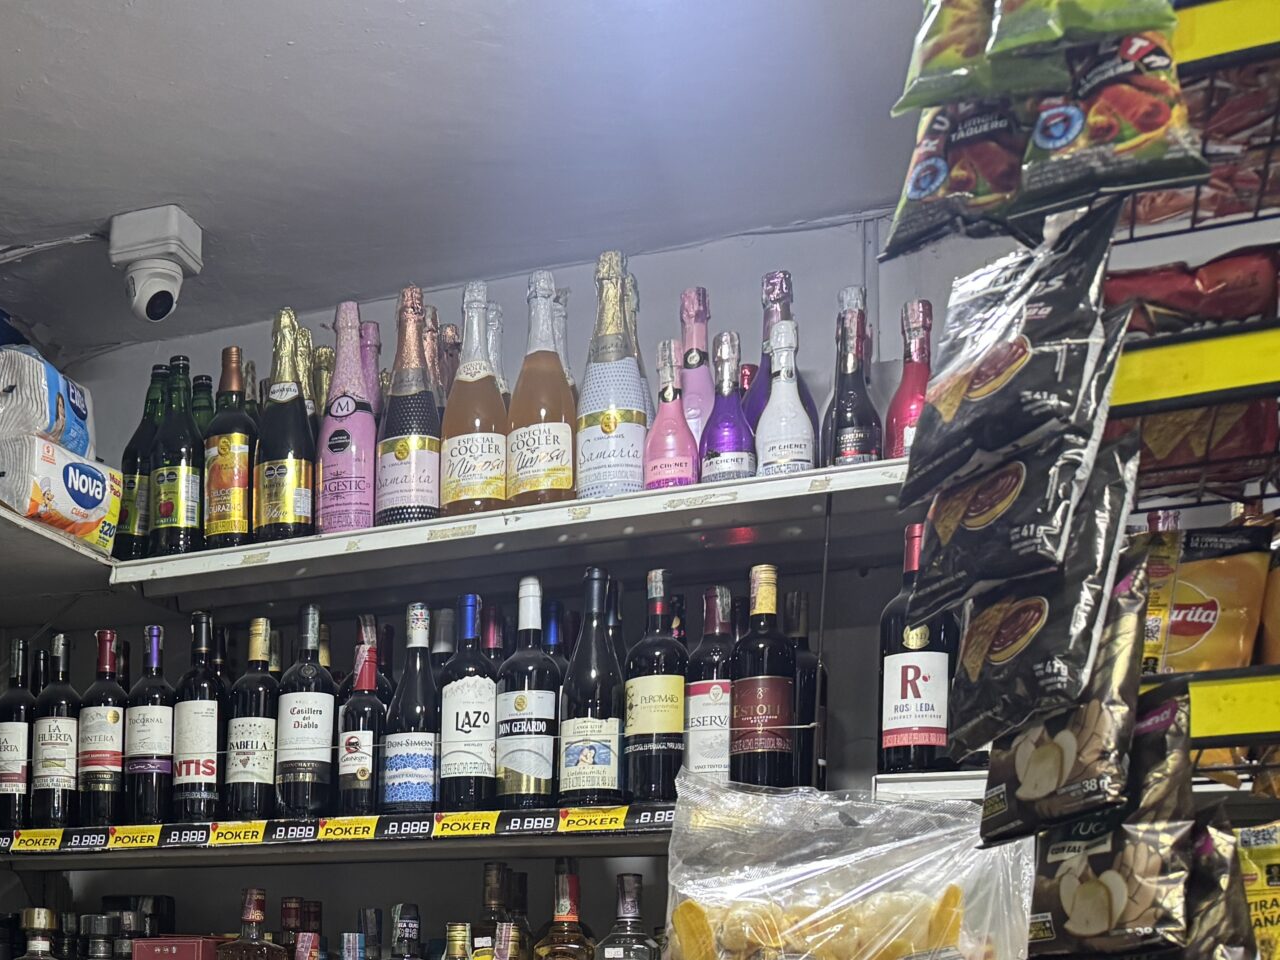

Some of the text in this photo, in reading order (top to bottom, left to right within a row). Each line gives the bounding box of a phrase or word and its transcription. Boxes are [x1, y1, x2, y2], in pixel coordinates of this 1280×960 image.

[515, 428, 552, 441] ESPECIAL
[457, 436, 495, 447] ESPECIAL
[510, 433, 561, 452] COOLER
[778, 444, 807, 452] CHENET
[450, 441, 501, 458] COOLER
[67, 470, 104, 500] Nova
[99, 520, 115, 538] 320
[289, 706, 323, 716] Casillero
[302, 714, 311, 722] del
[455, 710, 490, 735] LAZO
[47, 723, 61, 734] LA
[292, 720, 318, 730] Diablo
[497, 721, 547, 734] DON GERARDO
[38, 731, 73, 743] HUERTA
[387, 741, 403, 749] DON
[1082, 778, 1098, 793] 38
[17, 835, 58, 849] POKER
[114, 833, 155, 846] POKER
[216, 828, 260, 842] POKER
[324, 824, 371, 838] POKER
[440, 819, 491, 833] POKER
[565, 815, 619, 828] POKER
